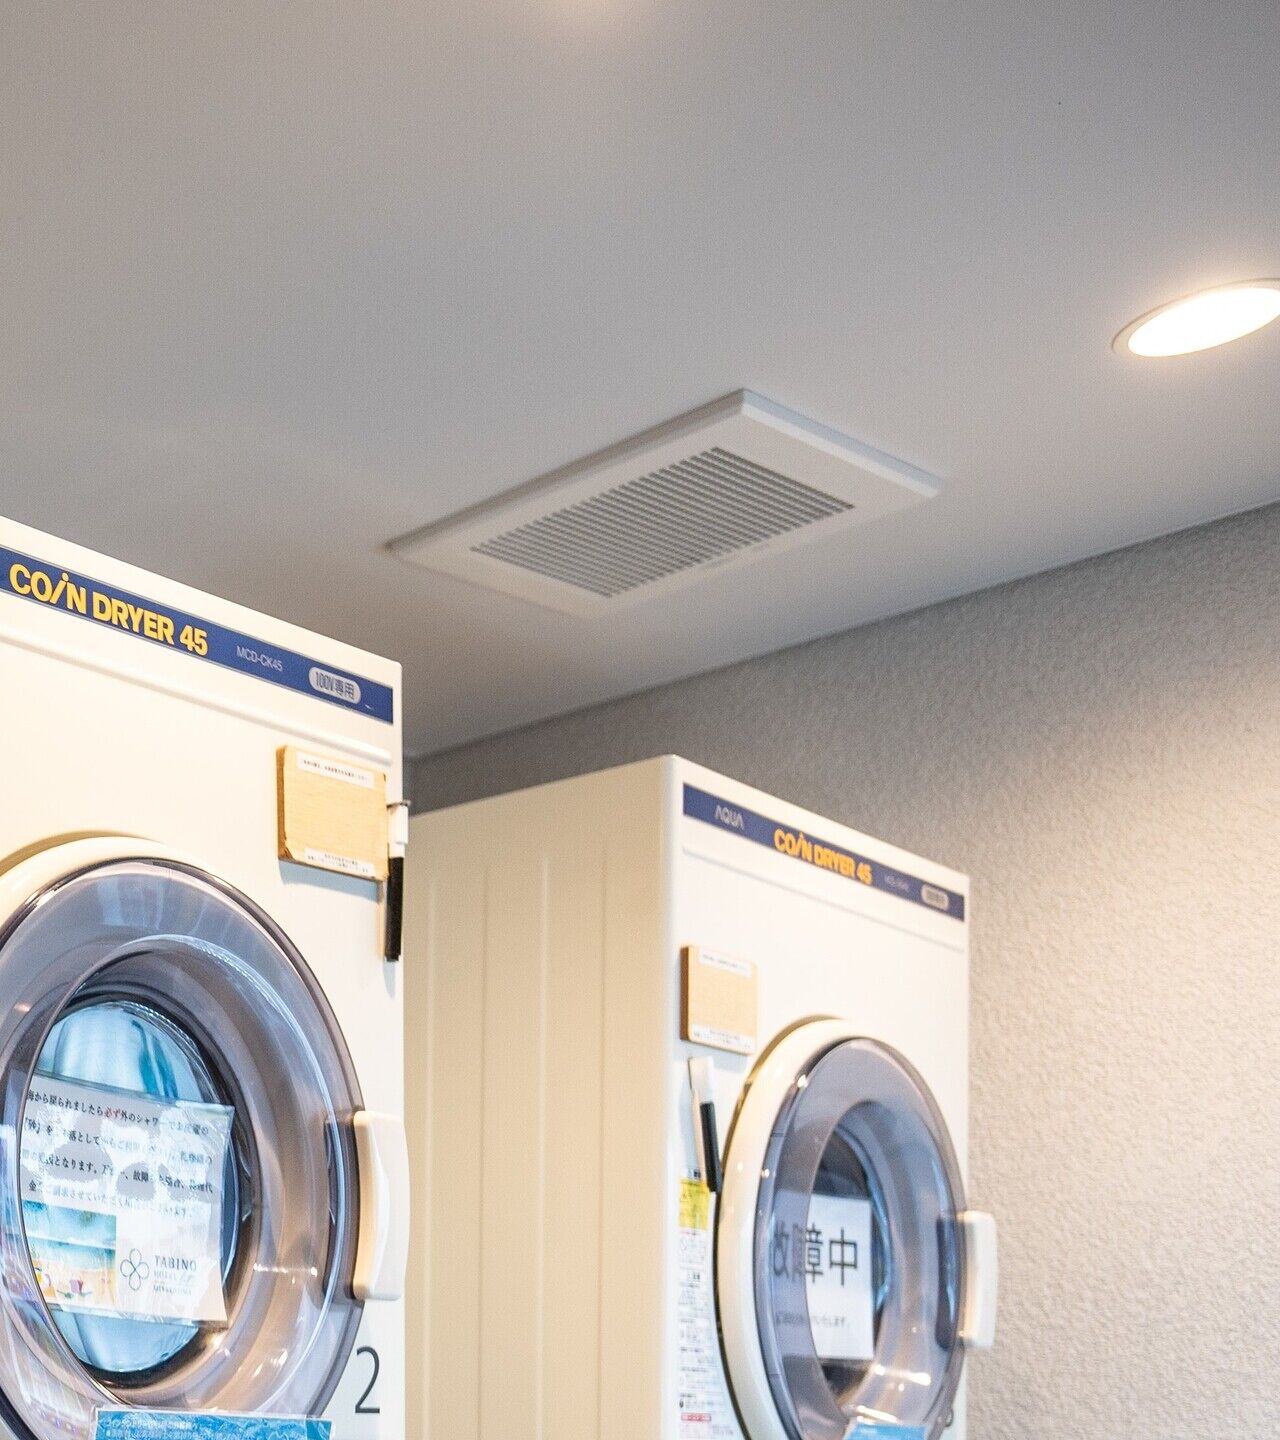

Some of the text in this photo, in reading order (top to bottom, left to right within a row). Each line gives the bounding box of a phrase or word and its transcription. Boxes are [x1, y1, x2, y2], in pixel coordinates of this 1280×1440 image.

[92, 591, 176, 646] DRYER
[179, 625, 209, 657] 45
[236, 645, 283, 673] MCD-CK45
[814, 844, 855, 880] DRYER
[856, 860, 873, 885] 45
[355, 1346, 381, 1414] 2
